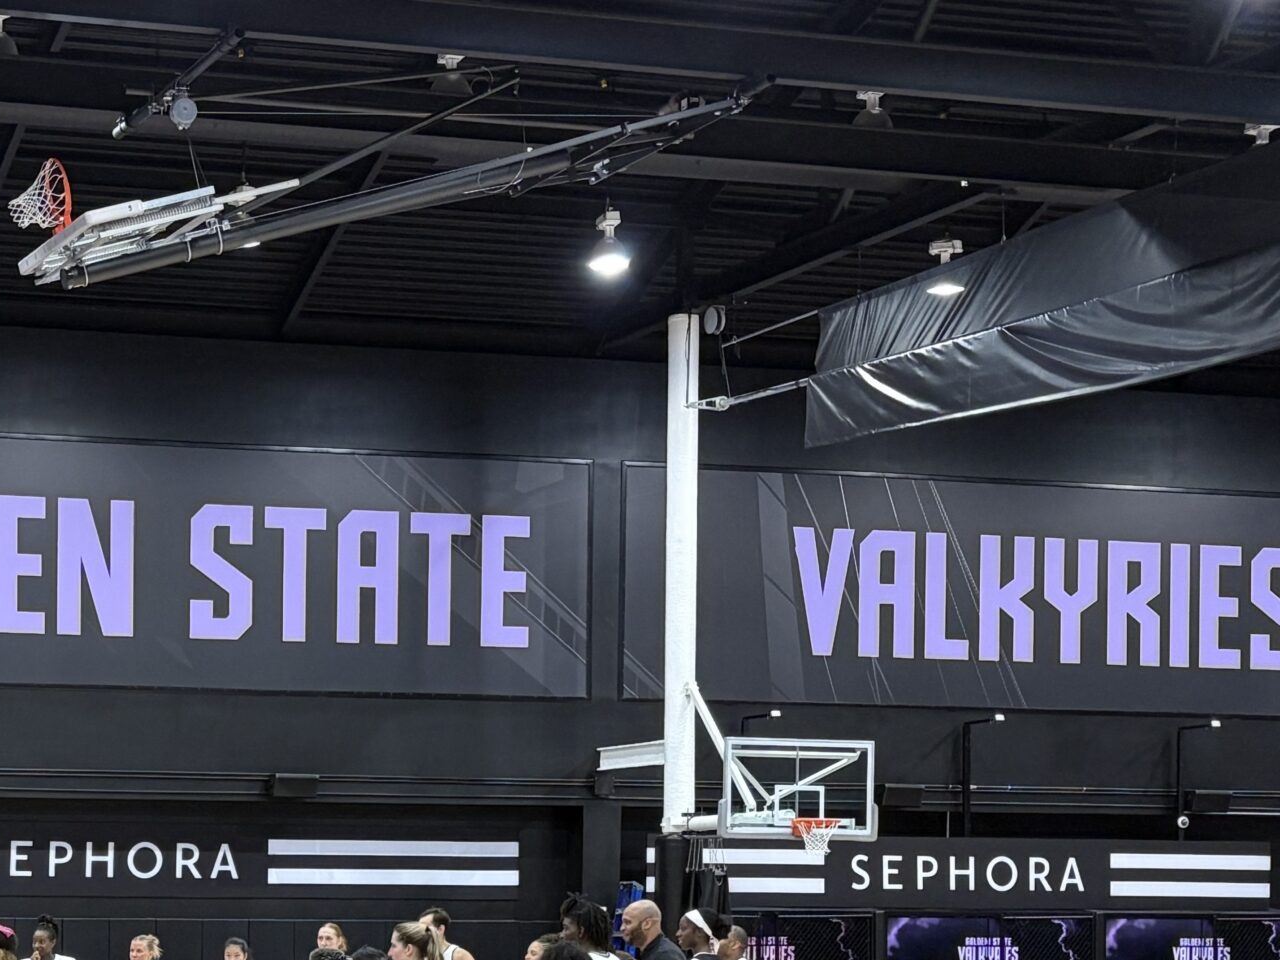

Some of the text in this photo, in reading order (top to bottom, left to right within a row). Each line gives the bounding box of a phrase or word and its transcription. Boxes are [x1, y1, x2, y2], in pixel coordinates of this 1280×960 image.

[189, 503, 531, 649] STATE
[793, 526, 1280, 670] VALKYRIES
[850, 854, 1086, 892] SEPHORA
[992, 936, 1012, 946] STTE
